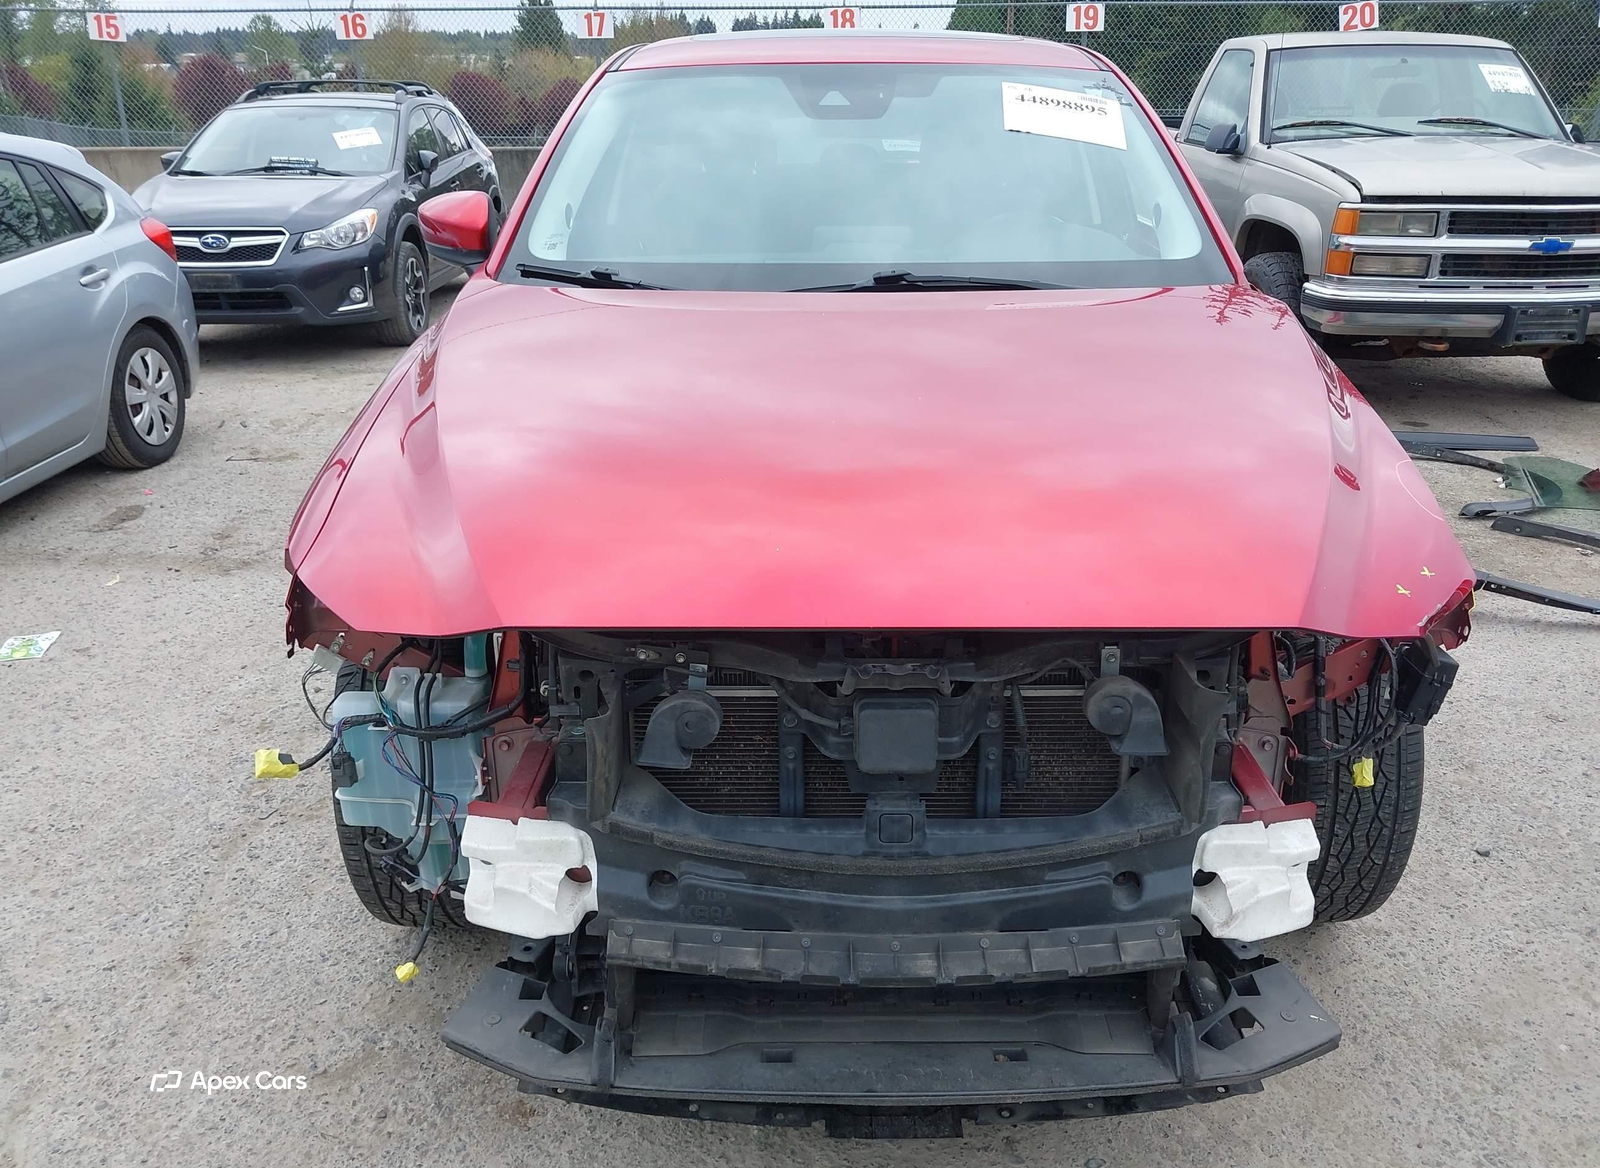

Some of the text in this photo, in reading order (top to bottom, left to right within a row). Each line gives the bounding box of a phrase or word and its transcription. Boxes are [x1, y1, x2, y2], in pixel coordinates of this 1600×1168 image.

[93, 14, 120, 40] 15
[340, 13, 367, 39] 16
[584, 12, 605, 37] 17
[830, 9, 856, 28] 18
[1072, 4, 1099, 30] 19
[1342, 2, 1376, 31] 20
[1015, 94, 1108, 116] 44898895
